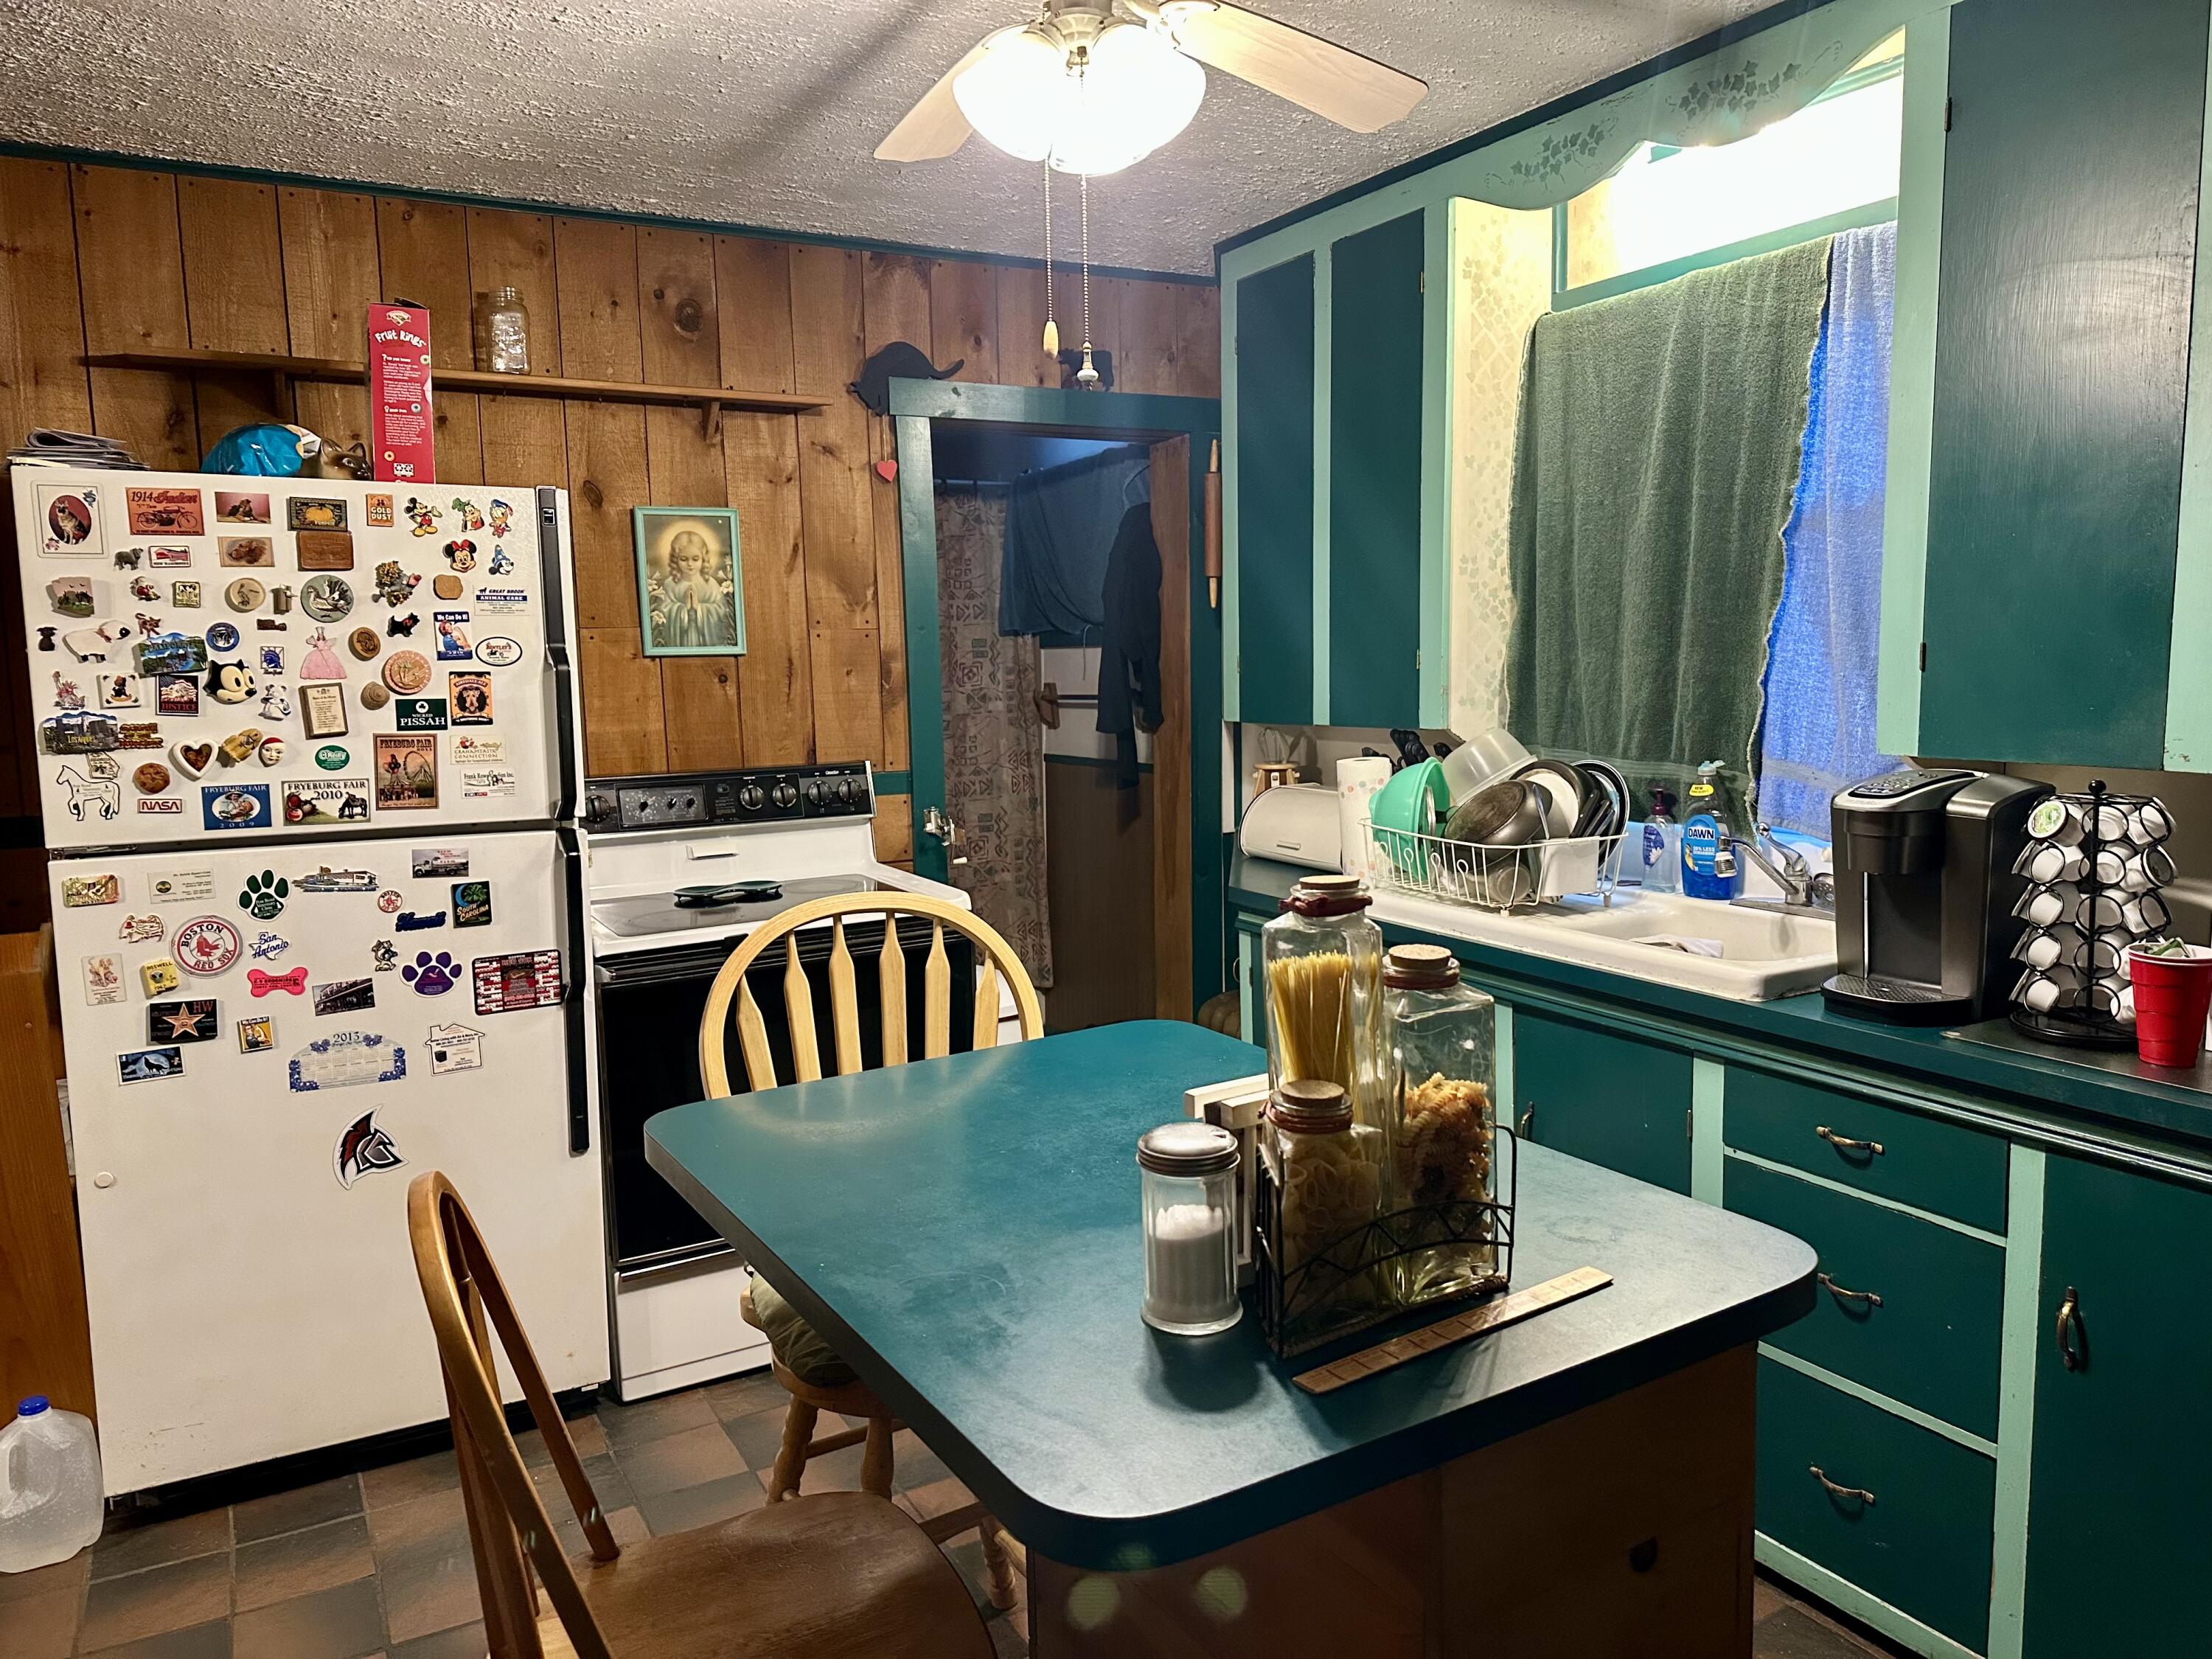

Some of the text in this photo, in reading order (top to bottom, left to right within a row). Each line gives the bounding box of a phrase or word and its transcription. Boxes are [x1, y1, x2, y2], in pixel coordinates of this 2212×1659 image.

[375, 330, 426, 348] Fruit Rings
[131, 491, 153, 502] 1914
[400, 717, 445, 726] PISSAH
[379, 739, 432, 748] FRYEBURG FAIR
[288, 781, 366, 791] FRYEBURG FAIR
[314, 790, 343, 801] 2010
[142, 801, 179, 810] NASA
[1688, 828, 1714, 839] DAWN
[456, 904, 478, 915] SOUTH
[460, 904, 489, 921] CAROLINA
[181, 923, 224, 947] BOSTON
[260, 933, 277, 945] San
[254, 940, 289, 957] Antonio
[193, 947, 234, 969] RED SOX
[147, 961, 173, 970] ROSWELL
[193, 1001, 213, 1013] HW
[333, 1031, 360, 1043] 2013
